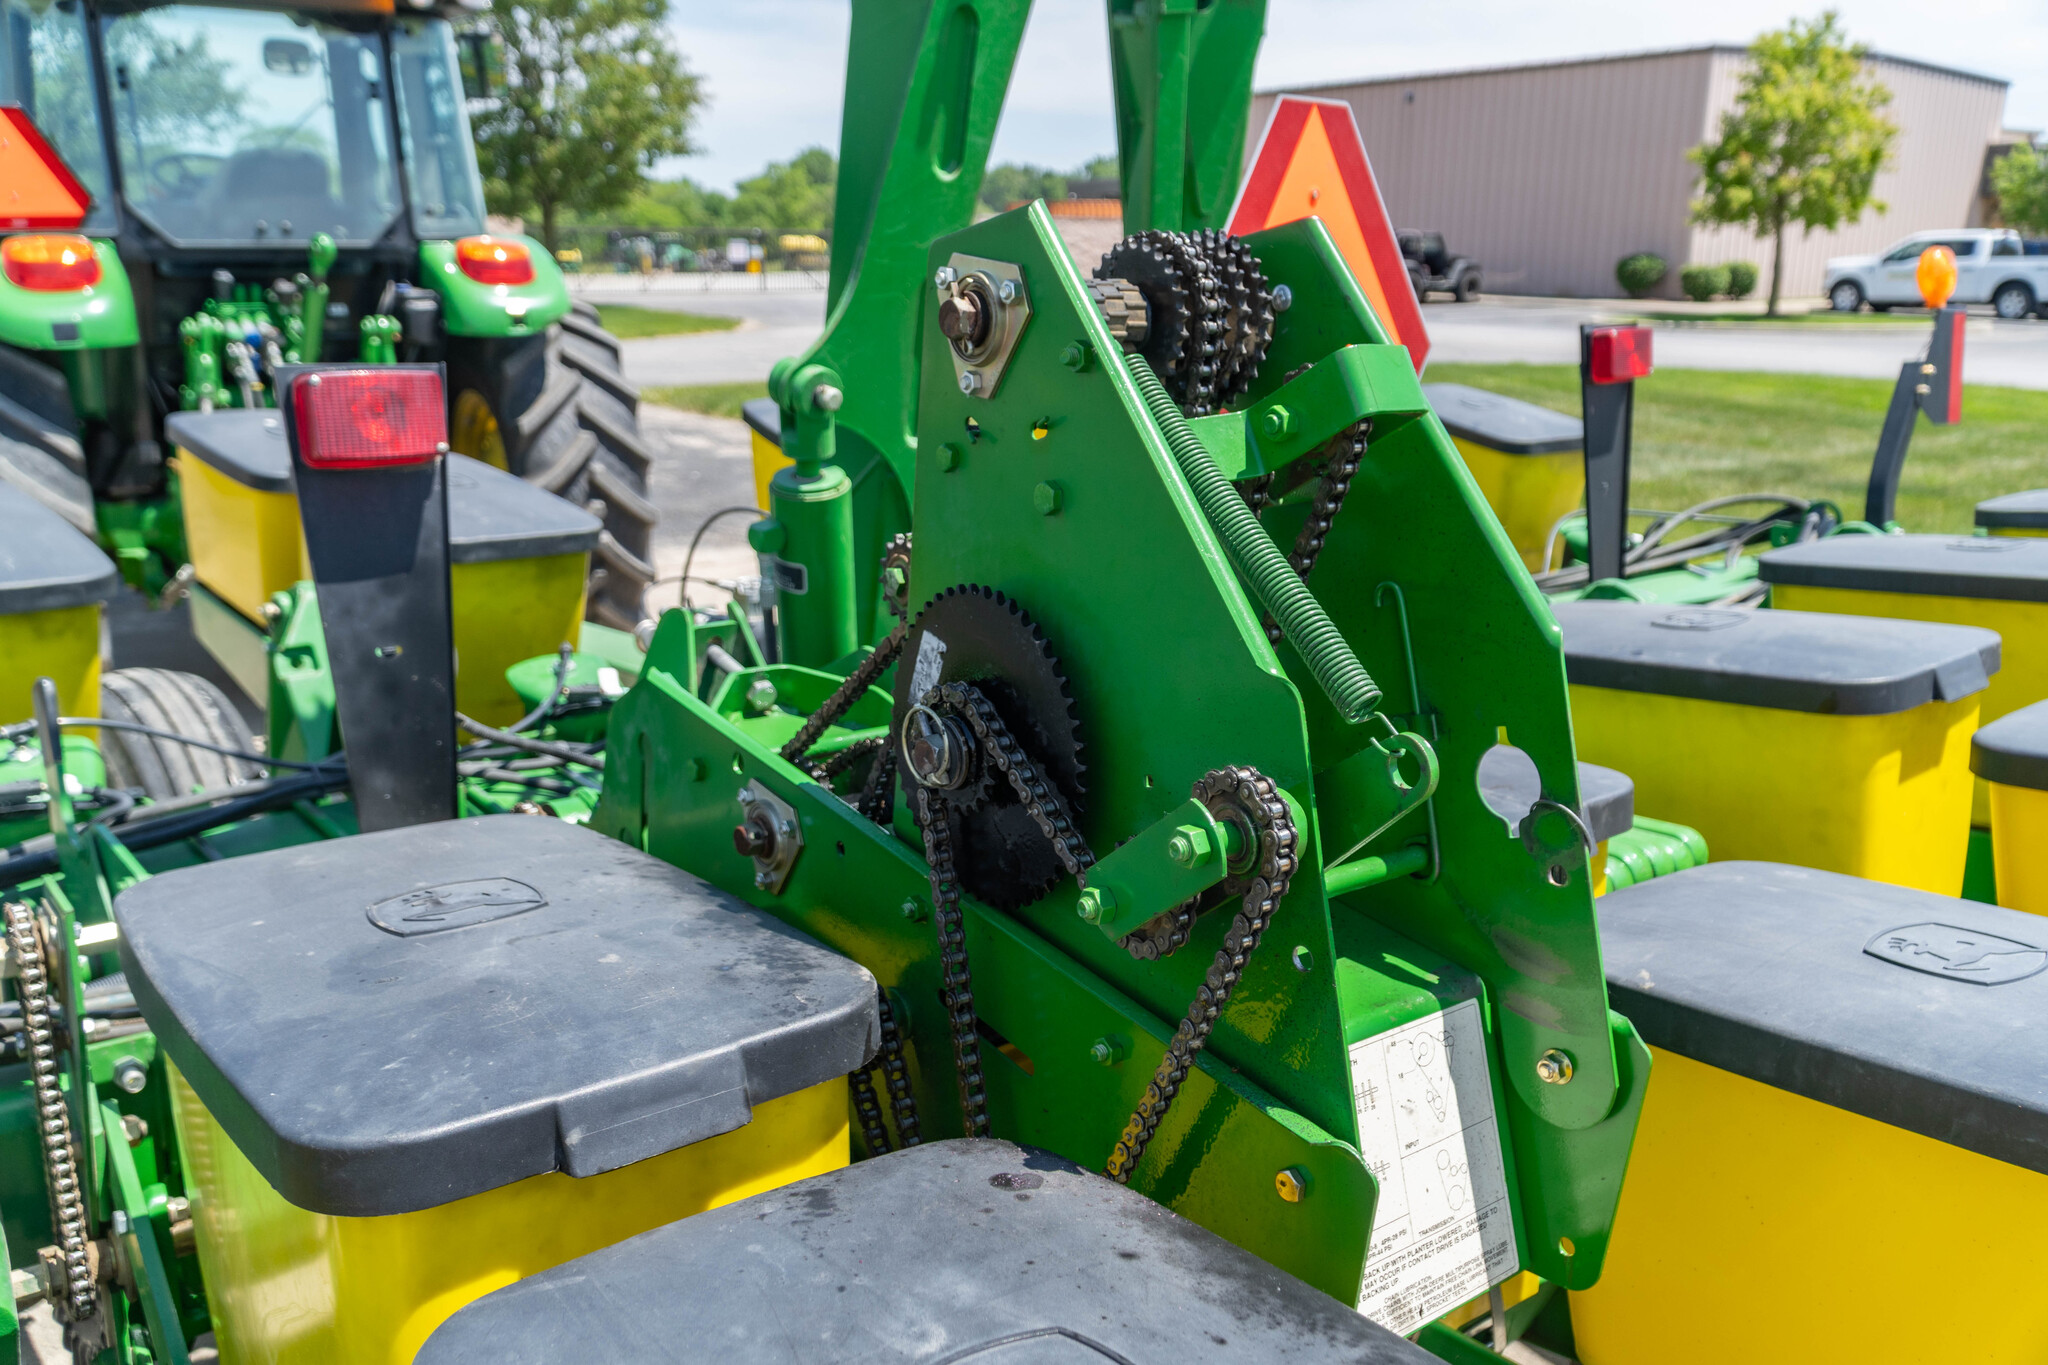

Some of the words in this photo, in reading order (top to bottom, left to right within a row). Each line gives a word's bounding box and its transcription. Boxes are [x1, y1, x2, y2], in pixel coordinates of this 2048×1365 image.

[1405, 1139, 1419, 1150] INPUT
[1418, 1215, 1455, 1236] TRANSMISSION
[1363, 1268, 1380, 1281] BACK
[1381, 1262, 1391, 1272] UP
[1391, 1254, 1407, 1267] WITH
[1407, 1240, 1433, 1258] PLANTER
[1466, 1211, 1489, 1229] DAMAGE
[1490, 1206, 1498, 1216] TO
[1364, 1279, 1378, 1291] MAY
[1379, 1266, 1400, 1283] OCCUR
[1401, 1263, 1407, 1272] IF
[1408, 1248, 1436, 1268] CONTACT
[1436, 1239, 1453, 1255] DRIVE
[1455, 1236, 1460, 1245] IS
[1461, 1221, 1487, 1241] ENGAGED
[1384, 1292, 1400, 1304] CHAIN
[1400, 1275, 1432, 1296] LUBRICATION
[1429, 1274, 1445, 1288] DEERE
[1362, 1282, 1390, 1302] BACKING
